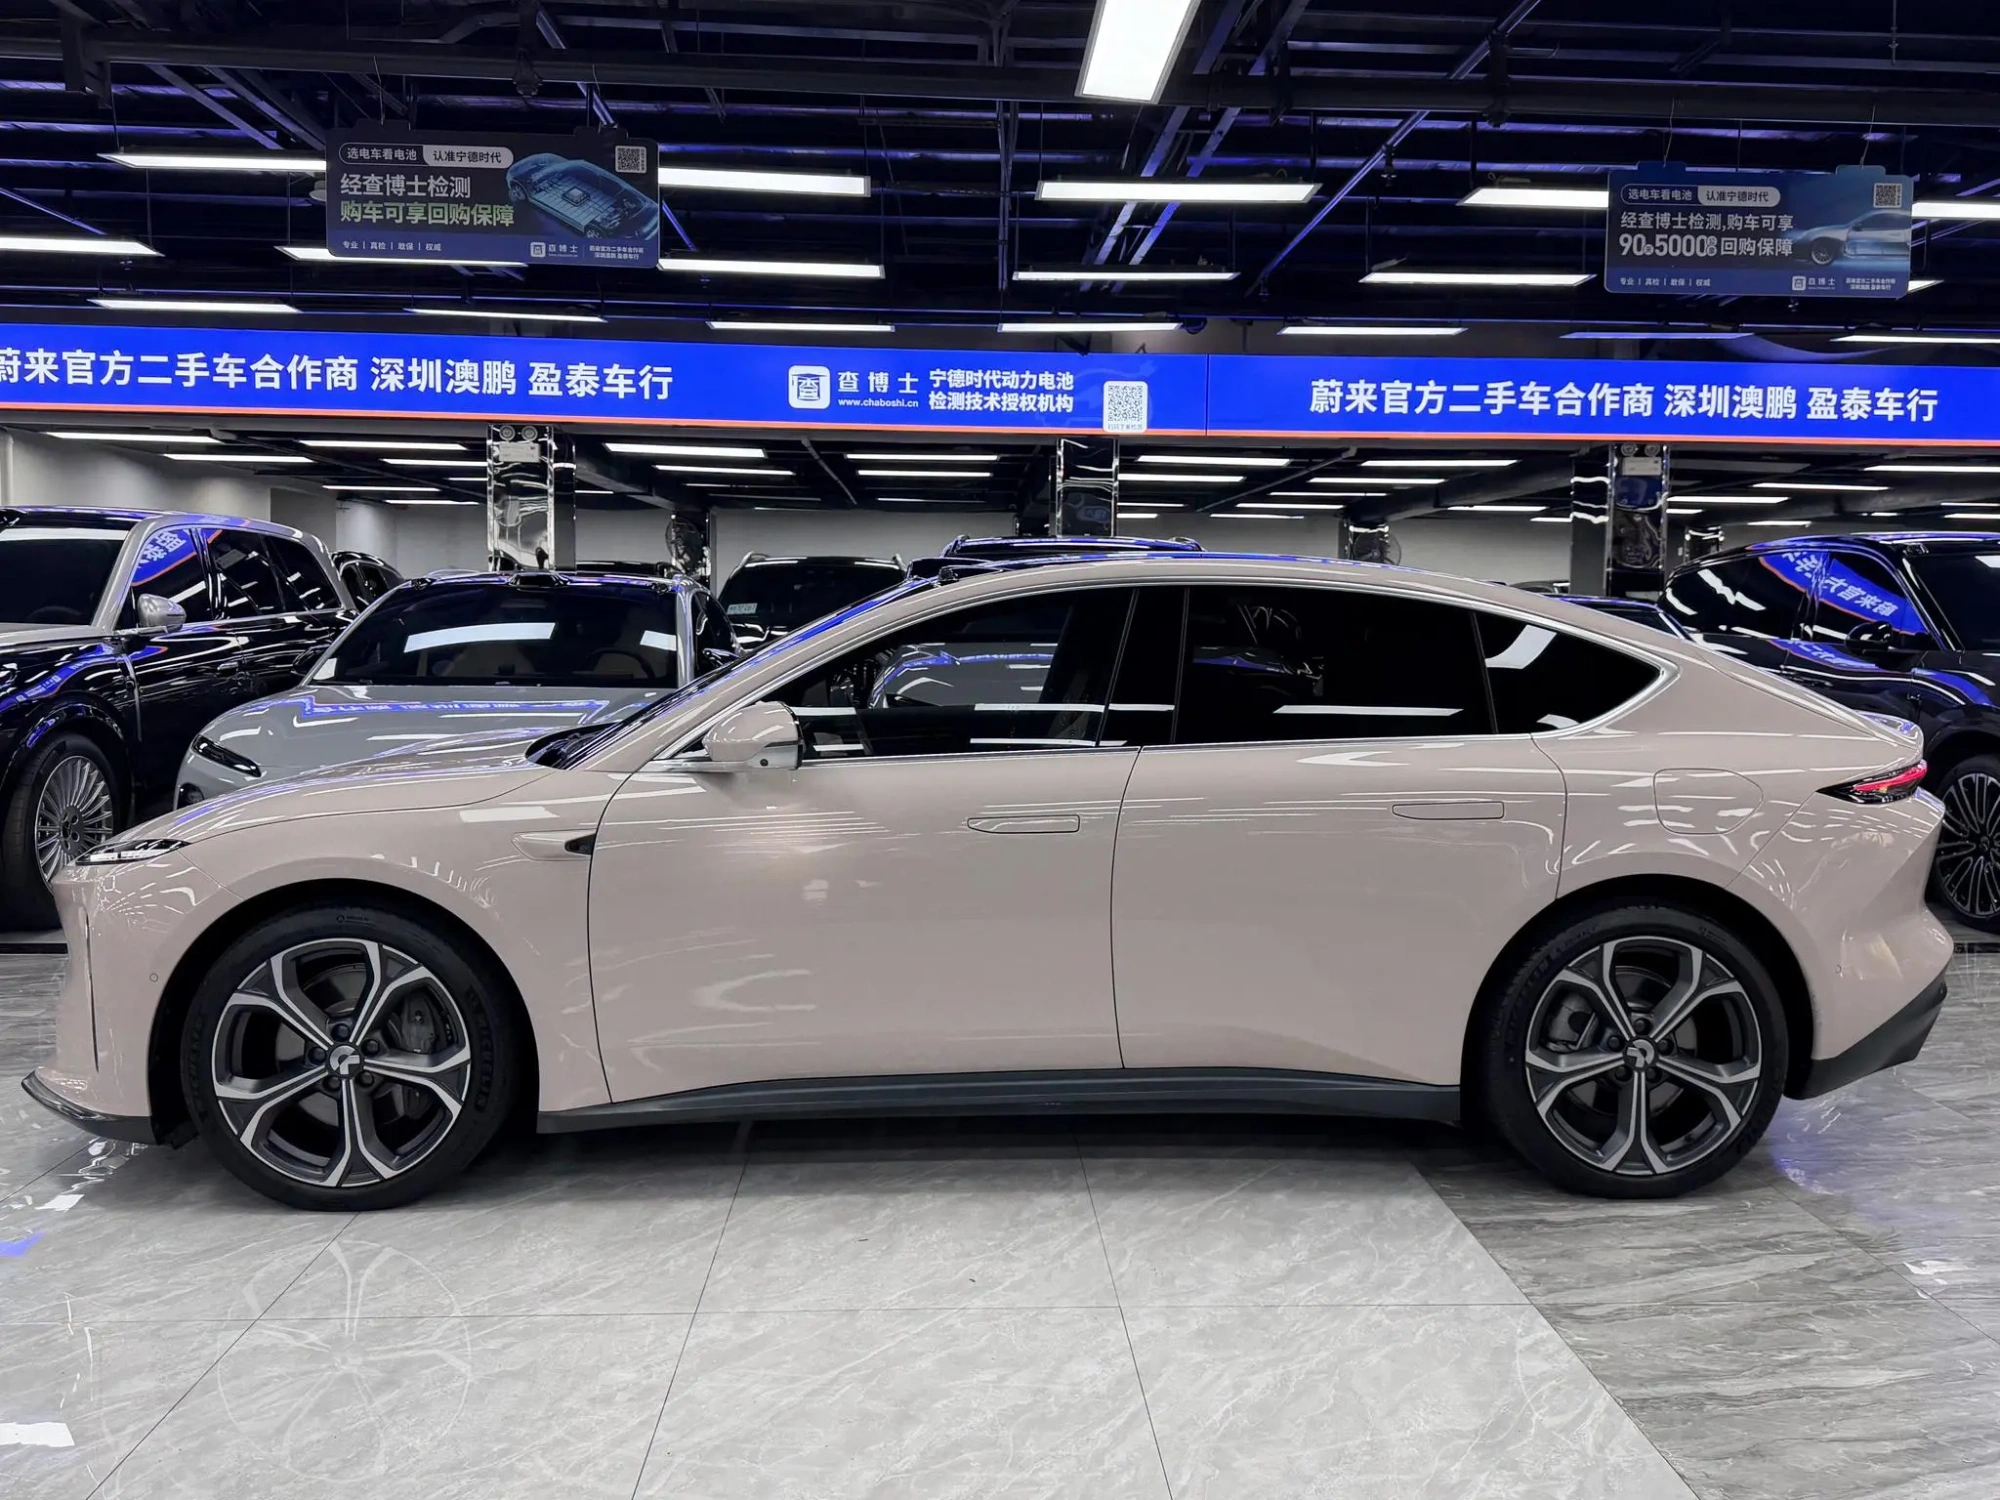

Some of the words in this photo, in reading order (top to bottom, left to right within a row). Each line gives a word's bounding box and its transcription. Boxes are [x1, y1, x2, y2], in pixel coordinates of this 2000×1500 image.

[347, 147, 417, 161] 选电车看电池
[433, 150, 502, 164] 认准宁德时代
[340, 173, 471, 199] 经查博士检测
[1628, 188, 1693, 201] 选电车看电池
[1706, 190, 1769, 203] 认准宁德时代
[340, 200, 515, 227] 购车可享回购保障
[1721, 237, 1793, 257] 回购保障
[371, 357, 515, 394] 深圳澳鹏
[529, 363, 672, 399] 盈泰车行
[839, 372, 918, 393] 查博士
[929, 368, 1074, 390] 宁德时代动力电池
[928, 390, 1074, 413] 检测技术授权机构
[1311, 380, 1653, 416] 蔚来官方二手车合作商
[1665, 385, 1796, 418] 深圳澳鹏
[1807, 388, 1937, 421] 盈泰车行
